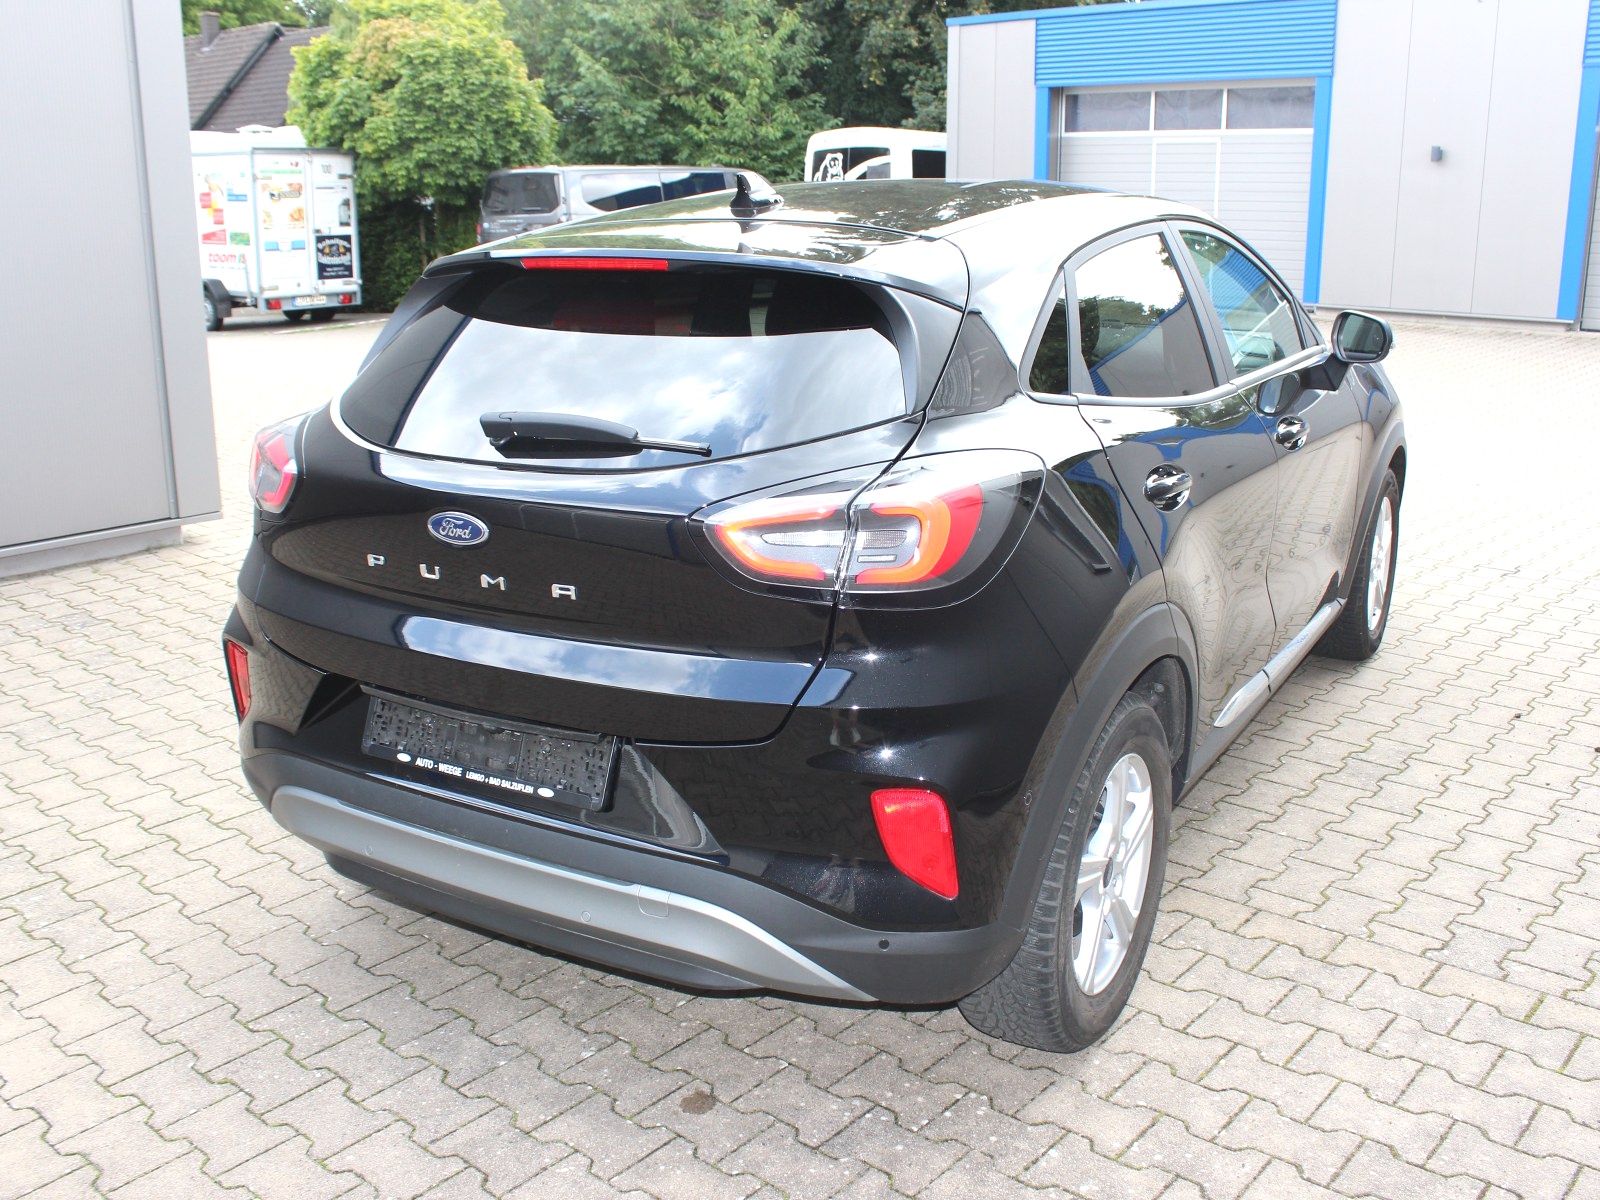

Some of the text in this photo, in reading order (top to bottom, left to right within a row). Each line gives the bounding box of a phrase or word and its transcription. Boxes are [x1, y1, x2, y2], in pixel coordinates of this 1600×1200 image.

[439, 517, 472, 539] Ford
[366, 553, 577, 601] PUMA
[415, 757, 433, 769] AUTO
[438, 763, 463, 777] WEEGE
[489, 777, 502, 787] BAD
[501, 779, 534, 794] SALZUFLEN
